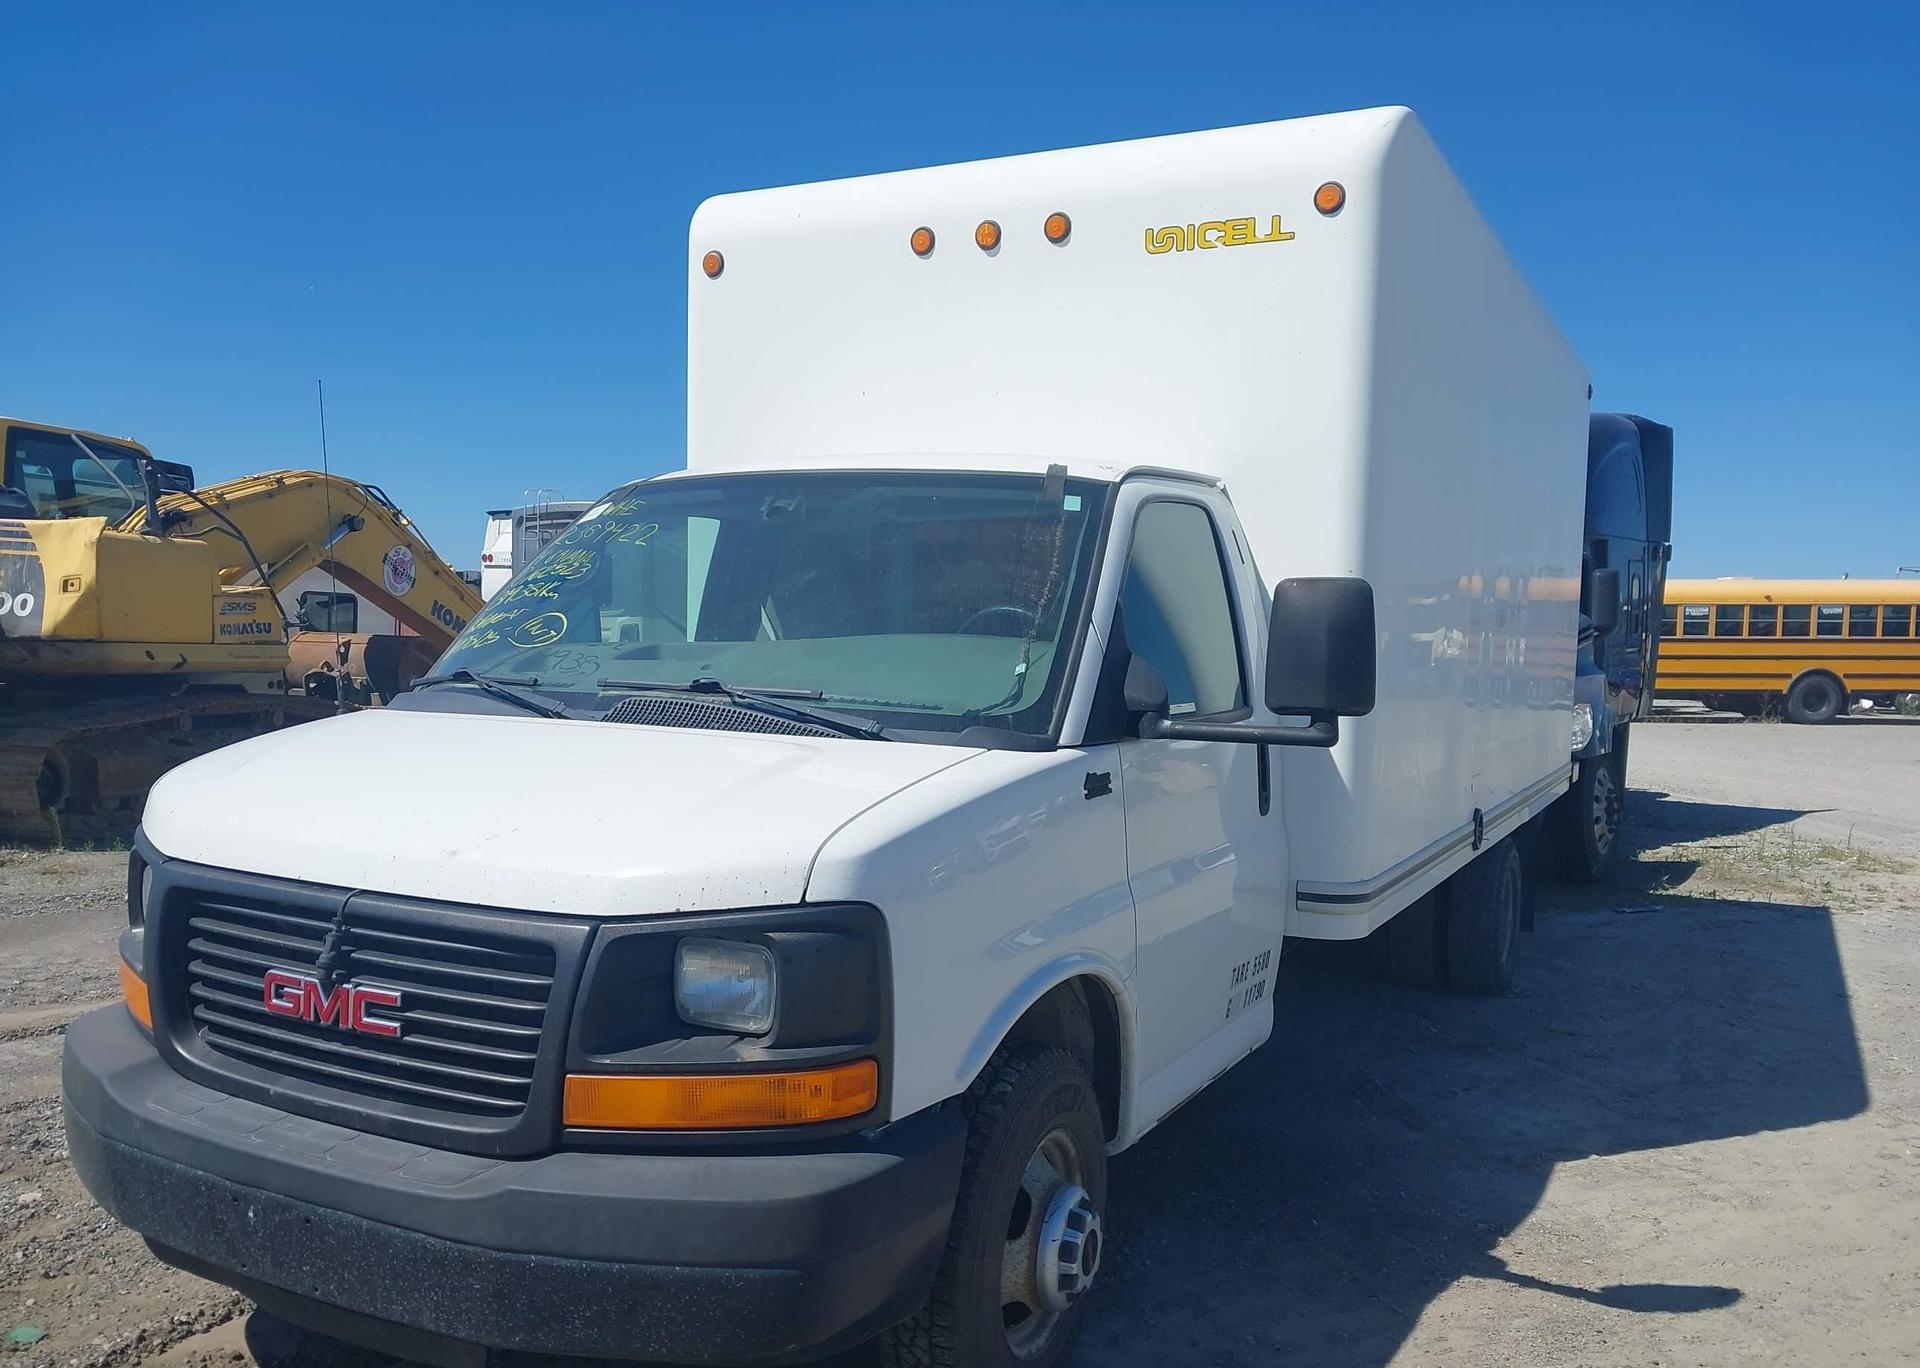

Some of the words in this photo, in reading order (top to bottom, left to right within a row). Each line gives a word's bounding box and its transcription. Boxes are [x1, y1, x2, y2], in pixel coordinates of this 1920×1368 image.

[219, 619, 272, 636] KOMATSU
[1230, 961, 1250, 989] TARE
[263, 968, 401, 1037] GMC
